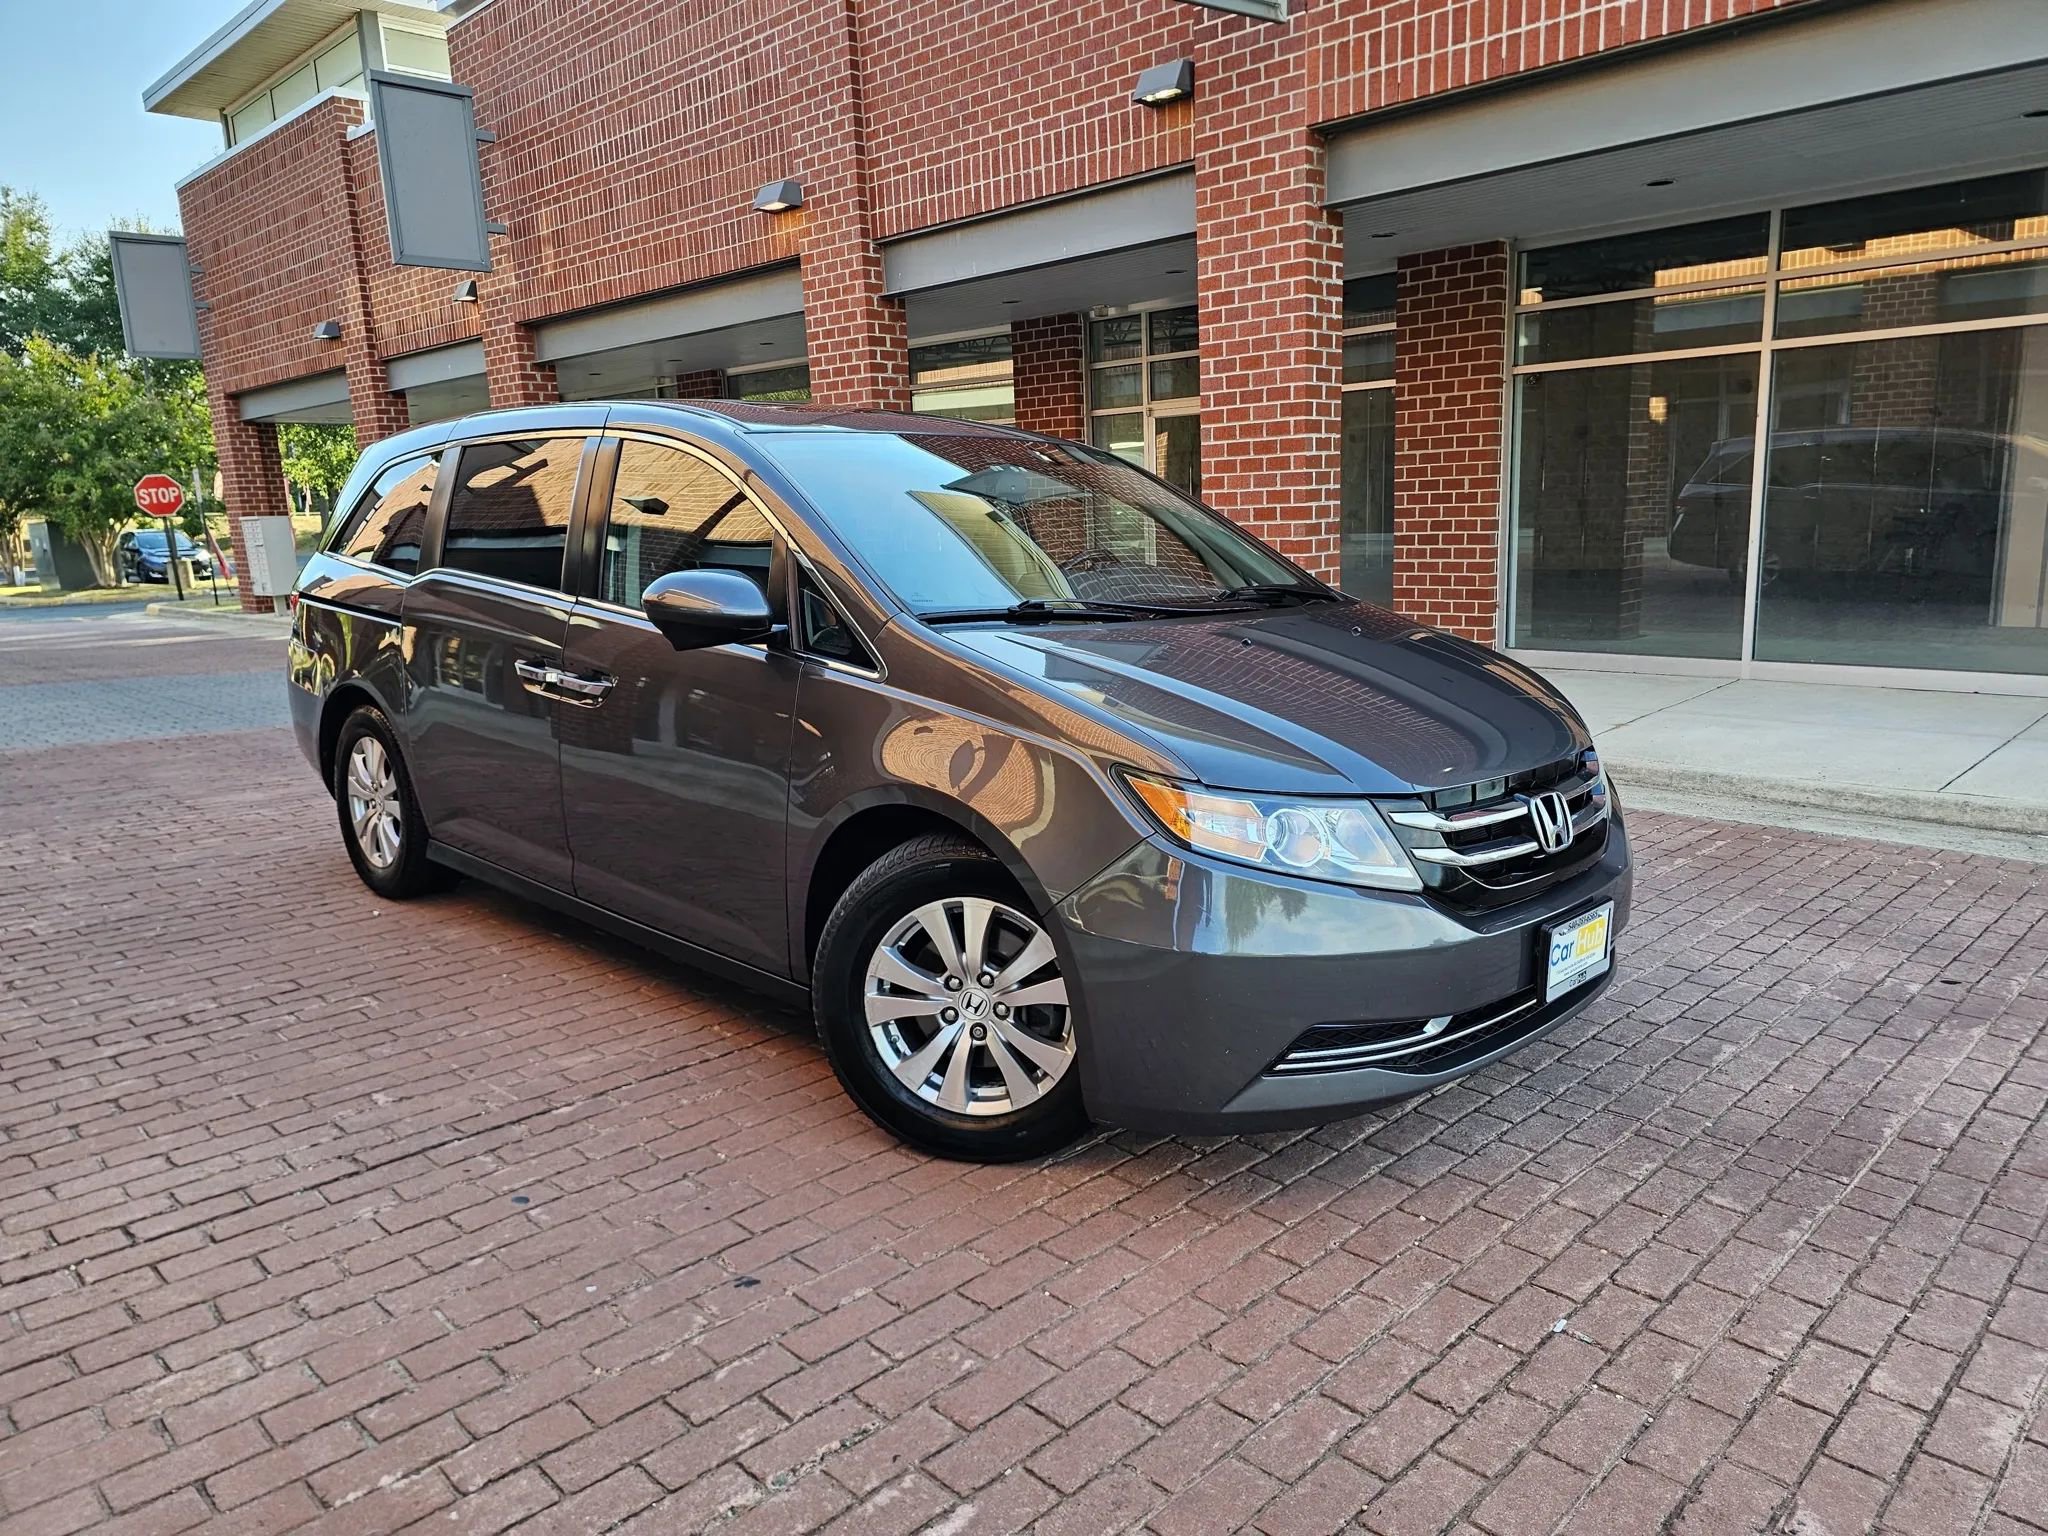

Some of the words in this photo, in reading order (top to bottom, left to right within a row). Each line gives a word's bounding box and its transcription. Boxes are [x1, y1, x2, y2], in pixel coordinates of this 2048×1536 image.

[138, 487, 179, 505] STOP
[1551, 940, 1575, 967] Car
[1577, 920, 1605, 957] Hub
